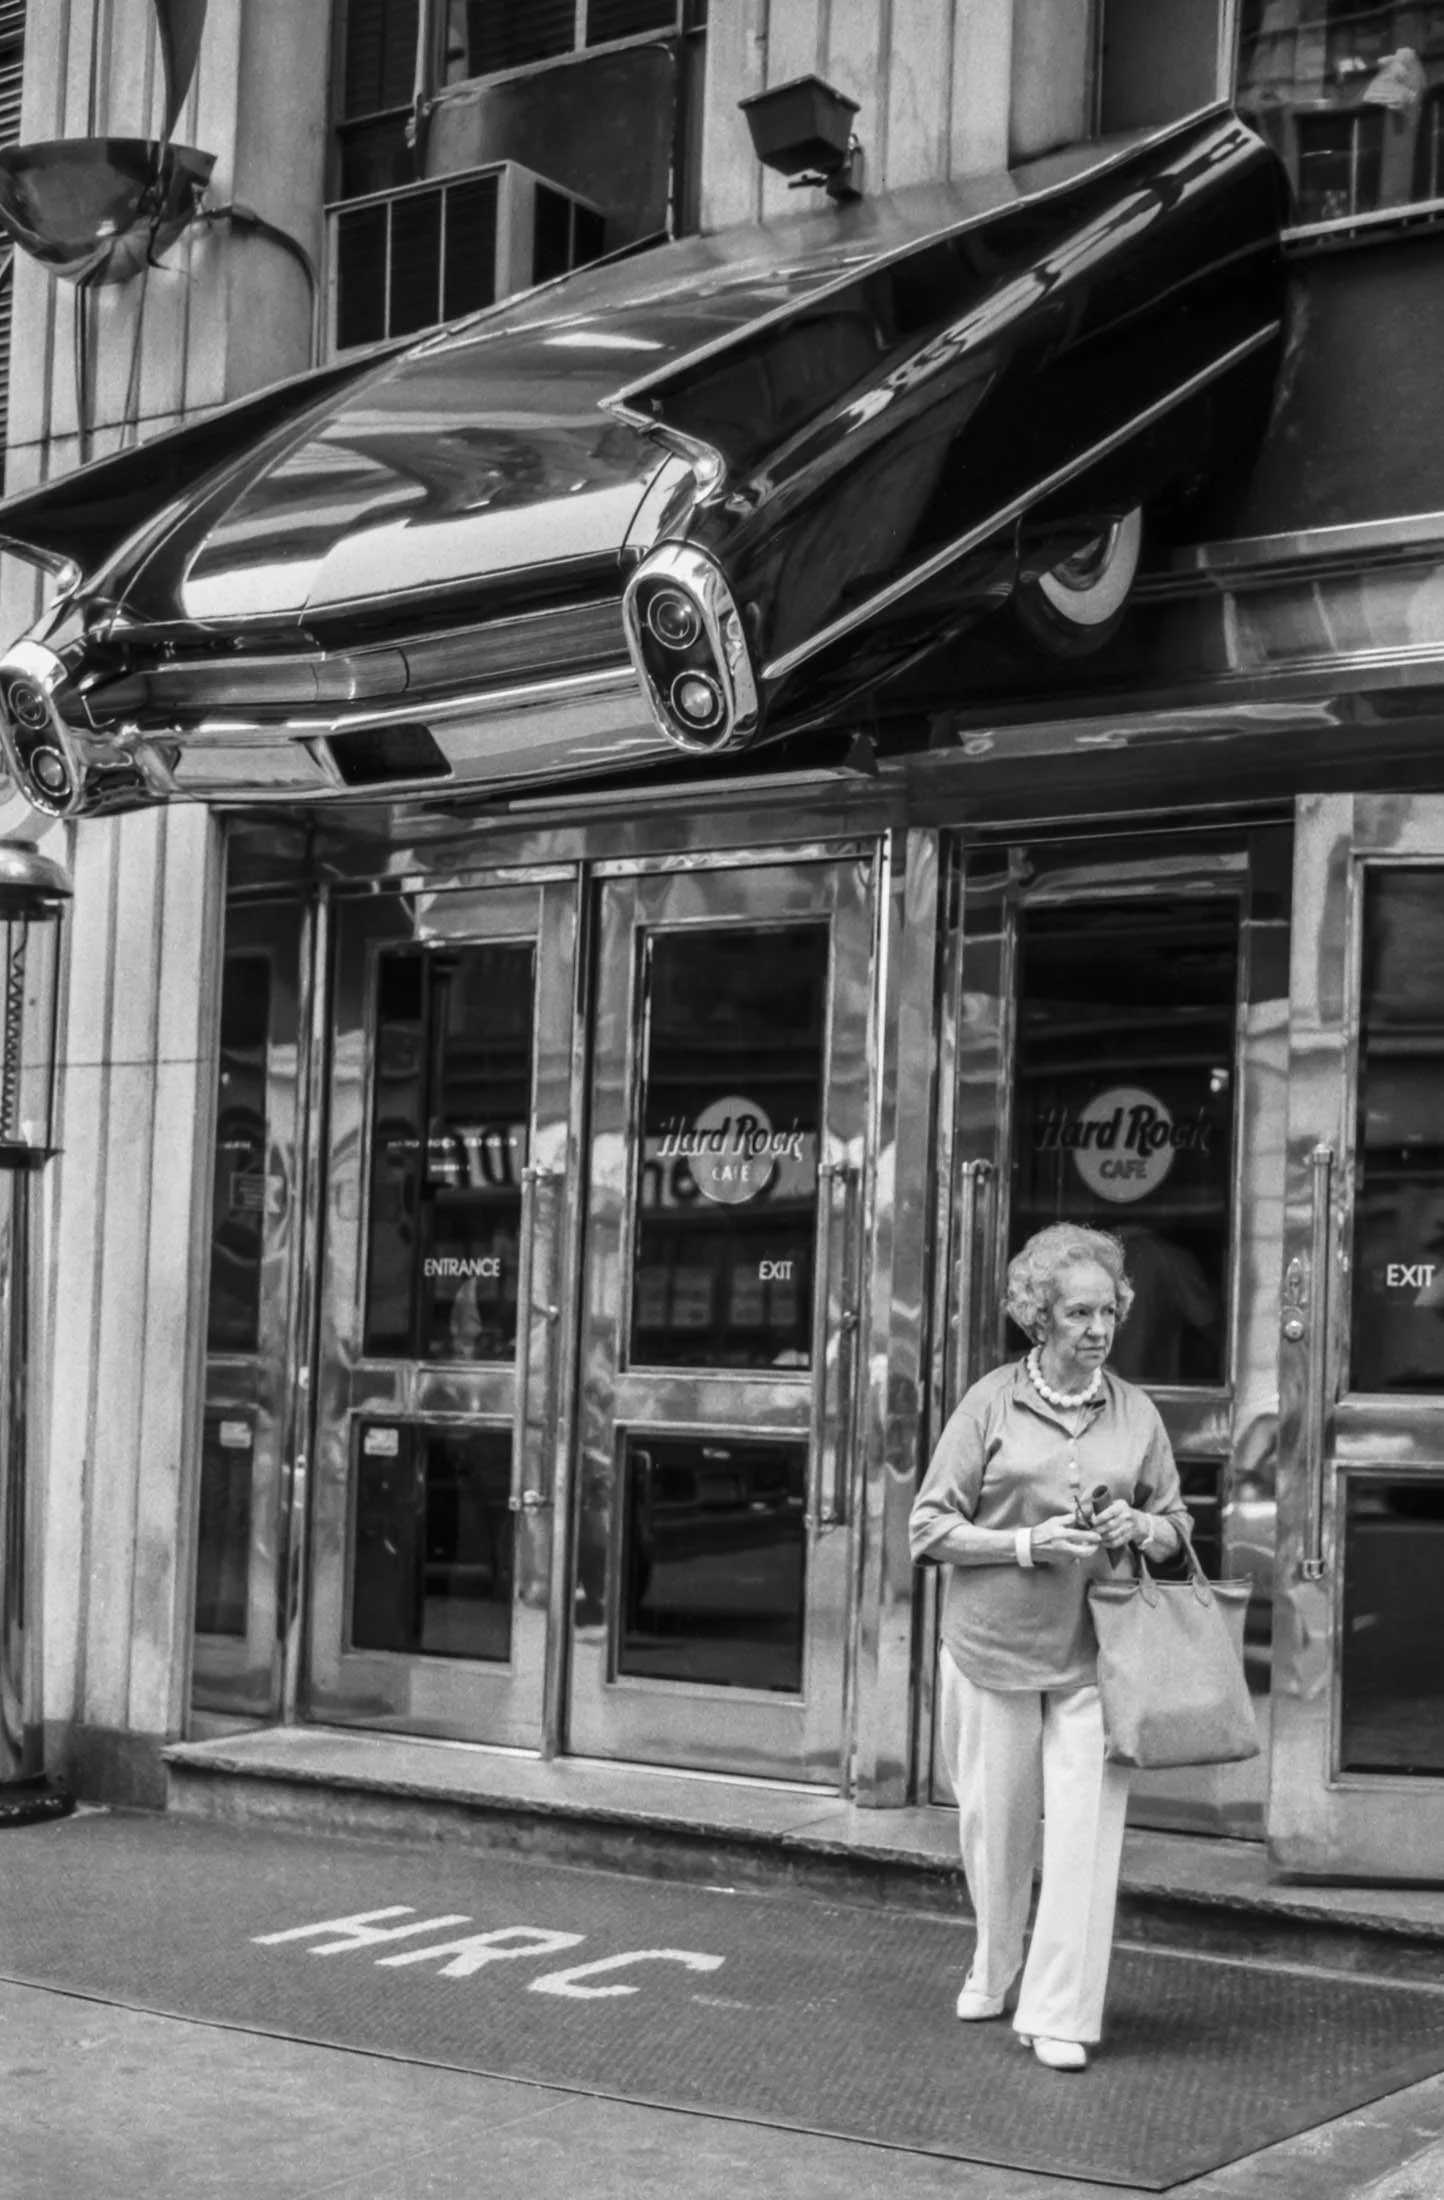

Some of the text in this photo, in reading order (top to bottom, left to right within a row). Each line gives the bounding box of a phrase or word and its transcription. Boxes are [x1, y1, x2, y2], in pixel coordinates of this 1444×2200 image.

[656, 1113, 805, 1163] Hard Rock
[1036, 1103, 1210, 1159] Hard Rock
[1099, 1158, 1149, 1180] CAFE
[423, 1257, 501, 1277] ENTRANCE
[759, 1260, 793, 1280] EXIT
[1386, 1263, 1436, 1288] EXIT
[250, 1905, 726, 1999] HRC
